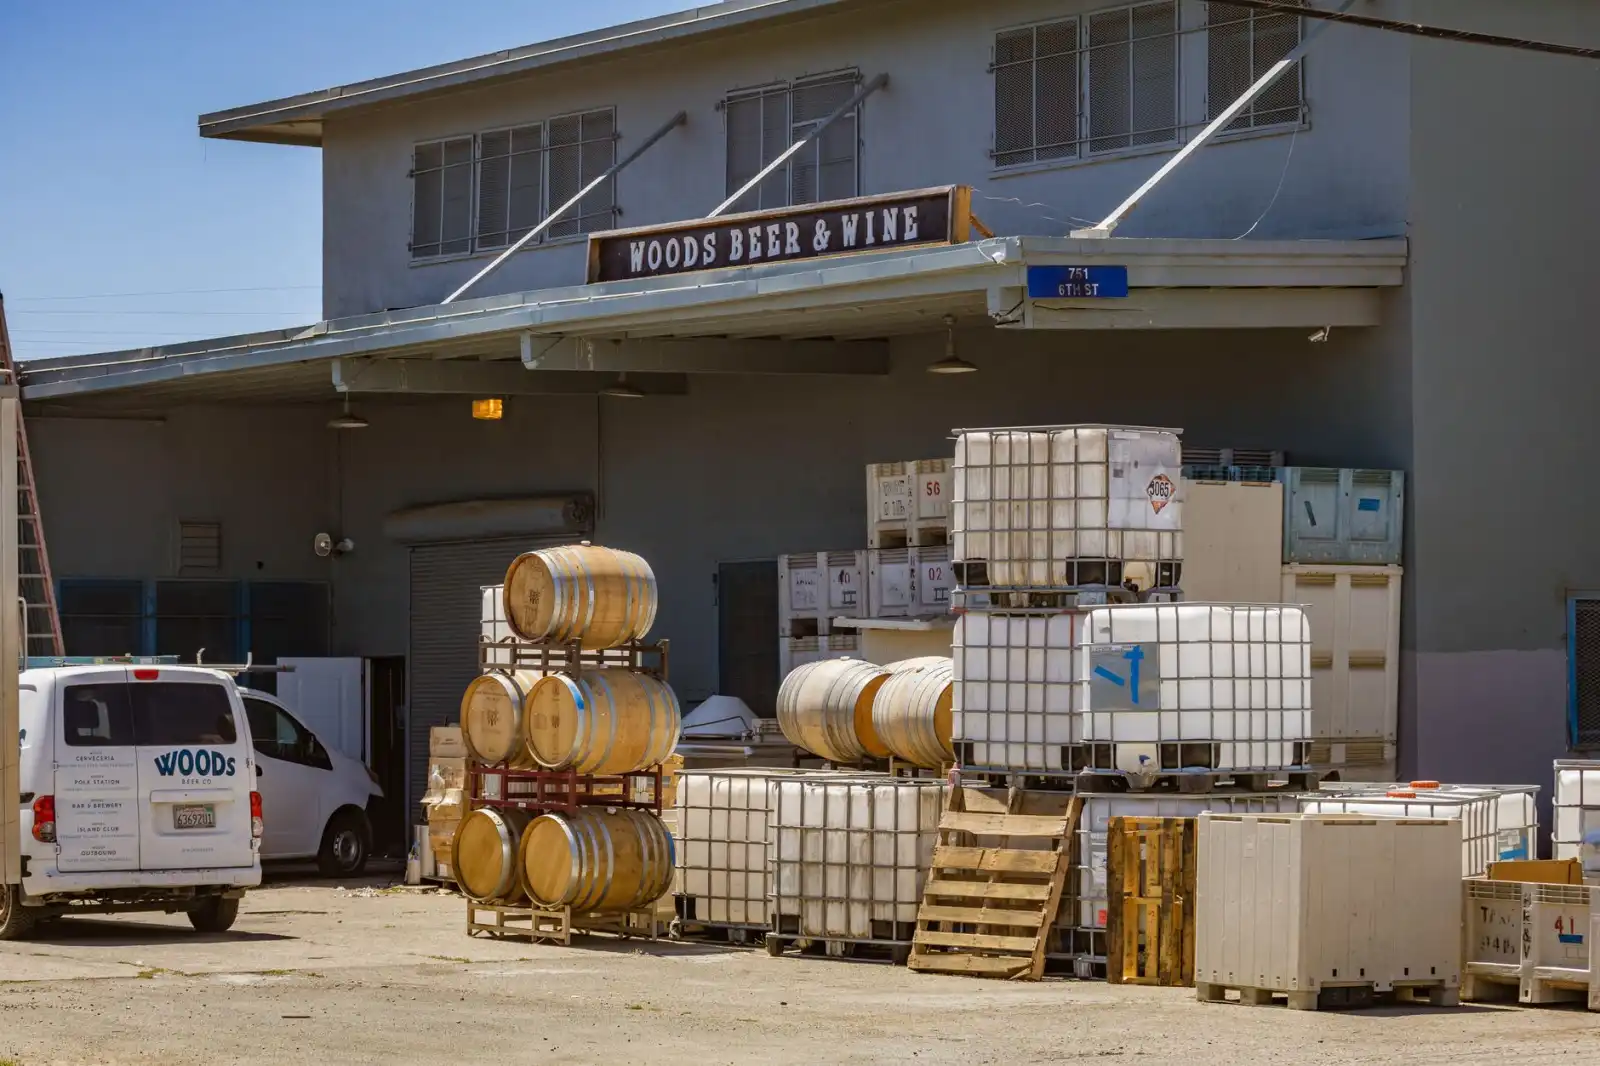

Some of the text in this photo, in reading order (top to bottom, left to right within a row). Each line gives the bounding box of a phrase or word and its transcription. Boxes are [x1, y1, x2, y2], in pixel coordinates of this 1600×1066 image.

[629, 205, 919, 273] WOODS BEER & WINE
[1068, 267, 1089, 280] 751
[1058, 283, 1099, 296] 6TH ST
[1148, 480, 1170, 498] 3065
[928, 567, 942, 581] 02
